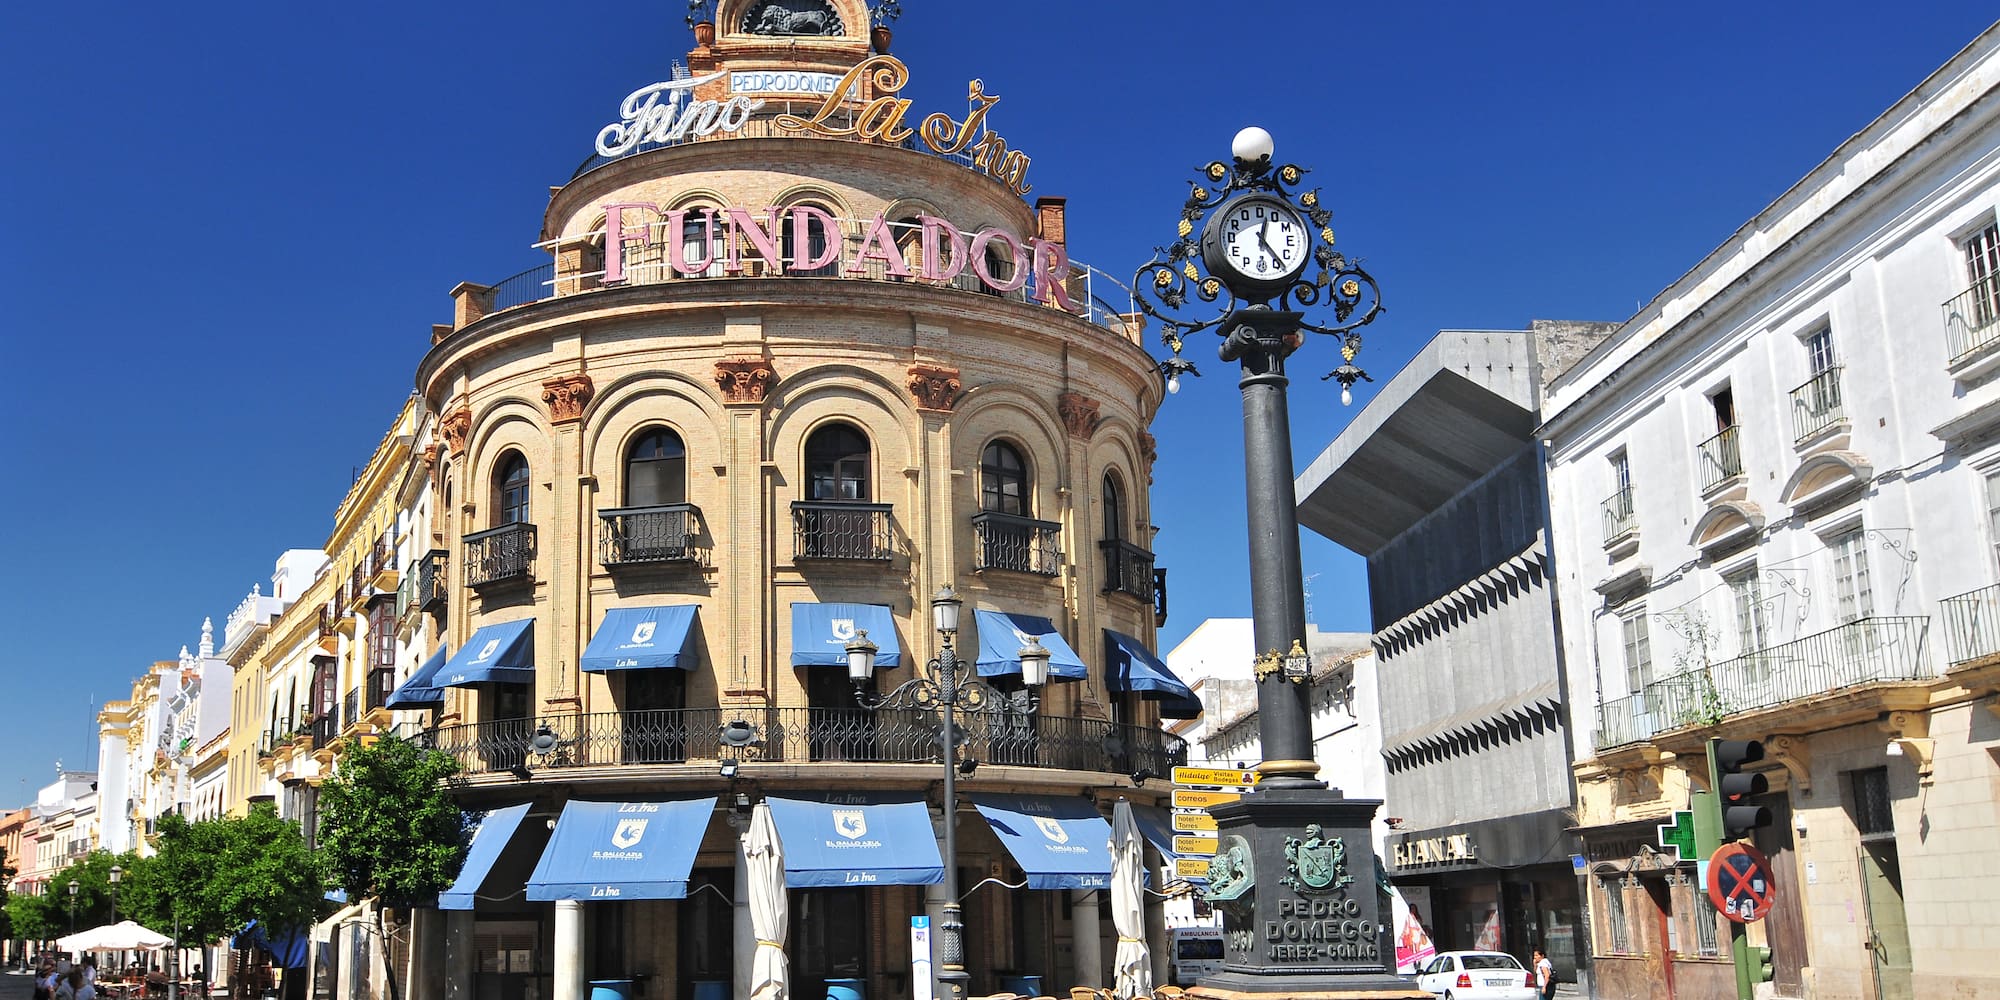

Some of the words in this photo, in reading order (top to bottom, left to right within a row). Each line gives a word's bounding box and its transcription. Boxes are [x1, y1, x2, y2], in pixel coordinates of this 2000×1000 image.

[732, 74, 787, 91] PEDRO
[787, 74, 856, 94] DOMEC
[596, 71, 765, 157] Fino
[774, 55, 913, 143] La
[599, 201, 1080, 312] FUNDADOR
[617, 802, 637, 813] La
[637, 802, 659, 813] Ina
[845, 871, 859, 883] La
[861, 872, 877, 882] Ina
[591, 886, 604, 897] La
[605, 885, 620, 897] Ina
[1278, 898, 1360, 916] PEDRO
[1265, 920, 1378, 942] DOMECQ
